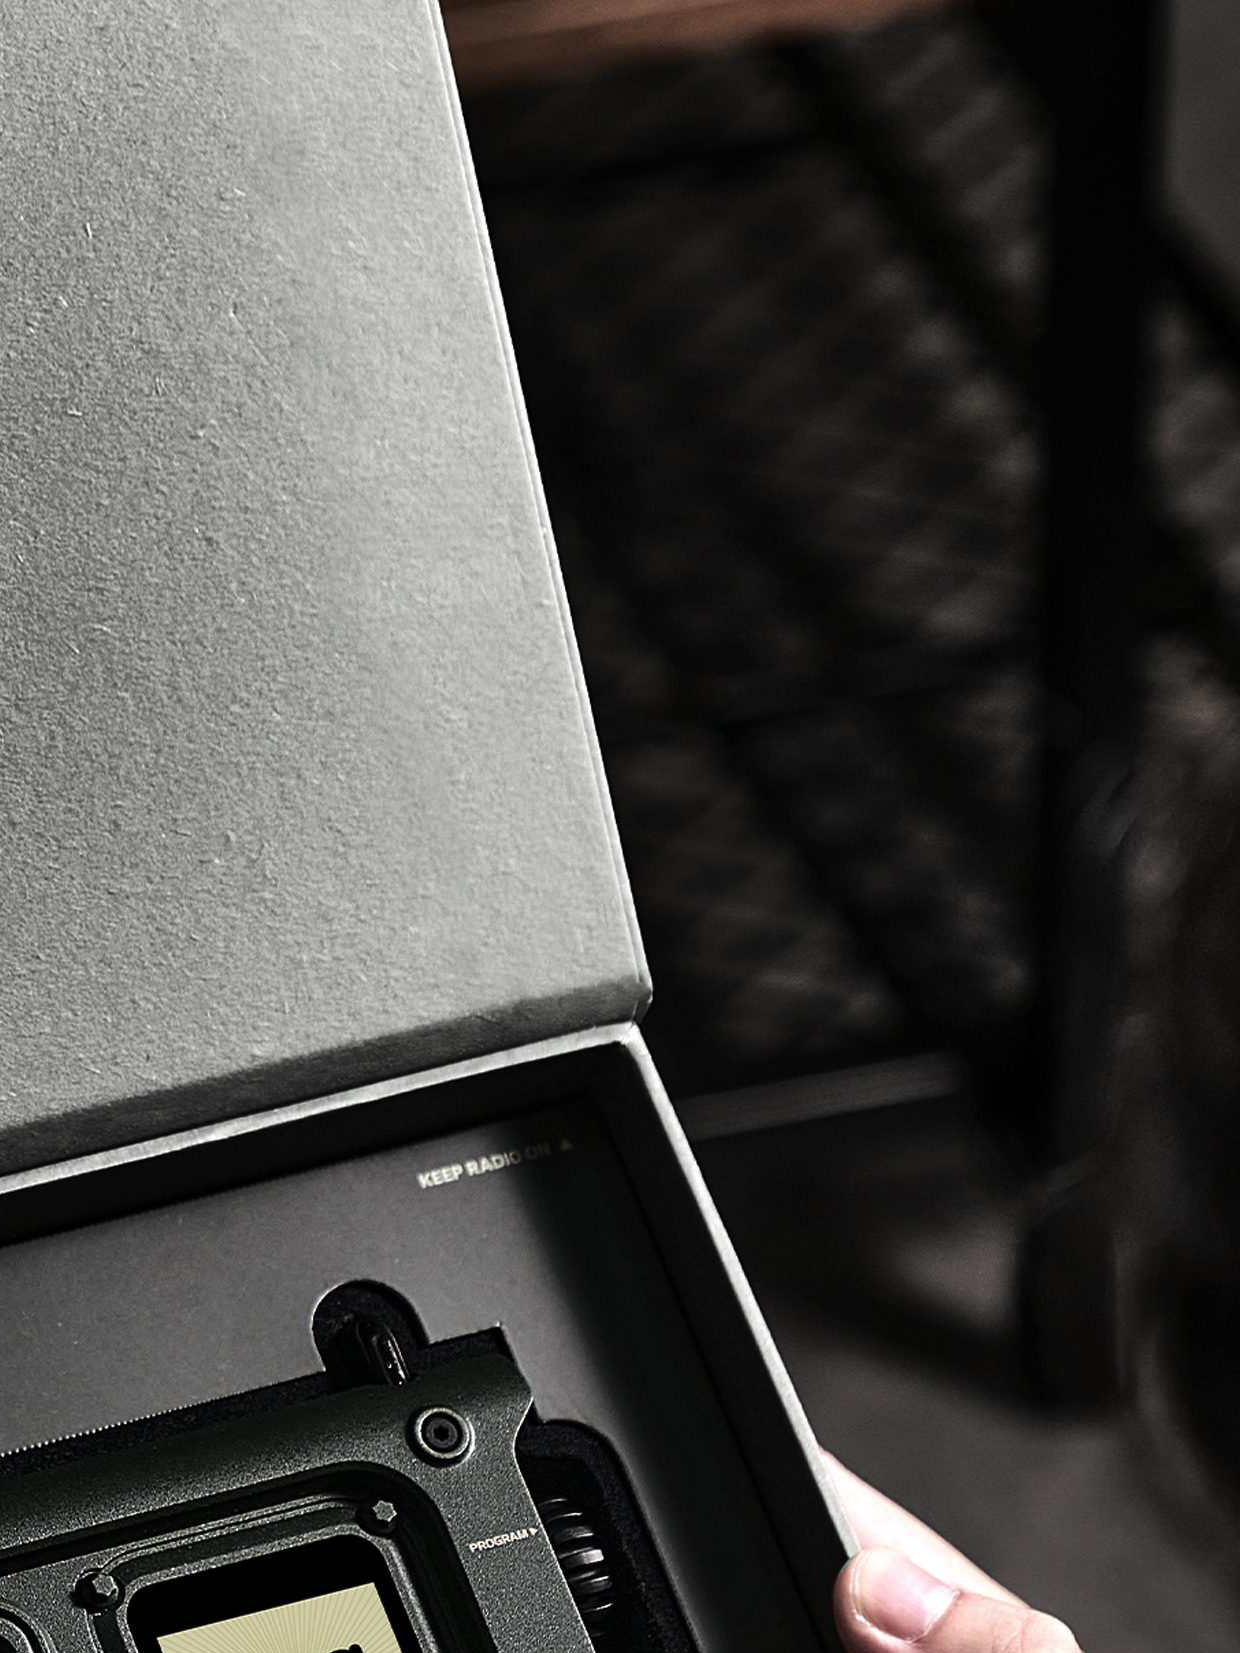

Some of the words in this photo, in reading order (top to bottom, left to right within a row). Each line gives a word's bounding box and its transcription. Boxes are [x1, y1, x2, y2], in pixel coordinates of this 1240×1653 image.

[416, 1163, 463, 1188] KEEP
[465, 1151, 521, 1176] RADIO
[469, 1530, 529, 1553] PROGRAM
